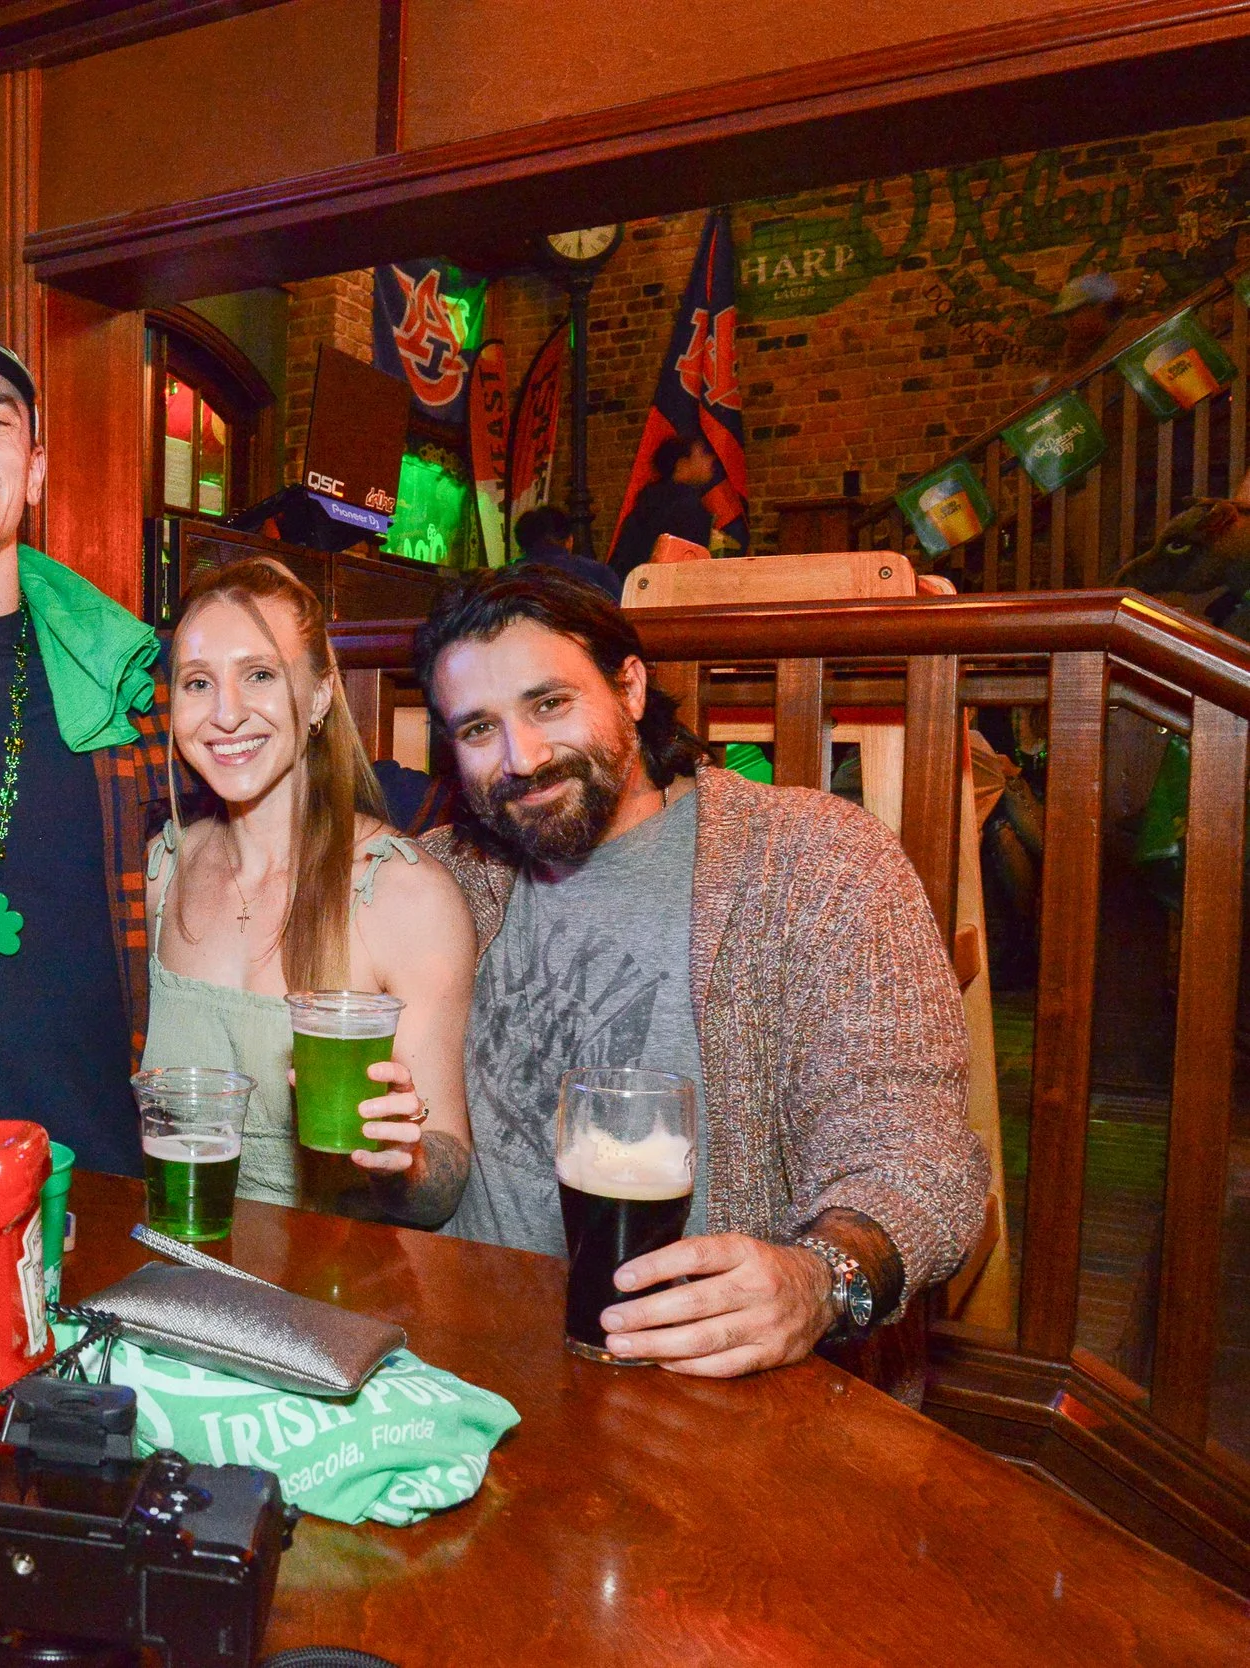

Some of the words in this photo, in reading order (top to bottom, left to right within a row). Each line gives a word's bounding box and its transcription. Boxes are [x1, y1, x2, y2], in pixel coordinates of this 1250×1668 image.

[740, 245, 855, 285] HARP
[307, 471, 345, 498] QSC
[331, 503, 368, 524] Pioneer
[199, 1395, 357, 1470] IRISH
[371, 1417, 436, 1450] Florida
